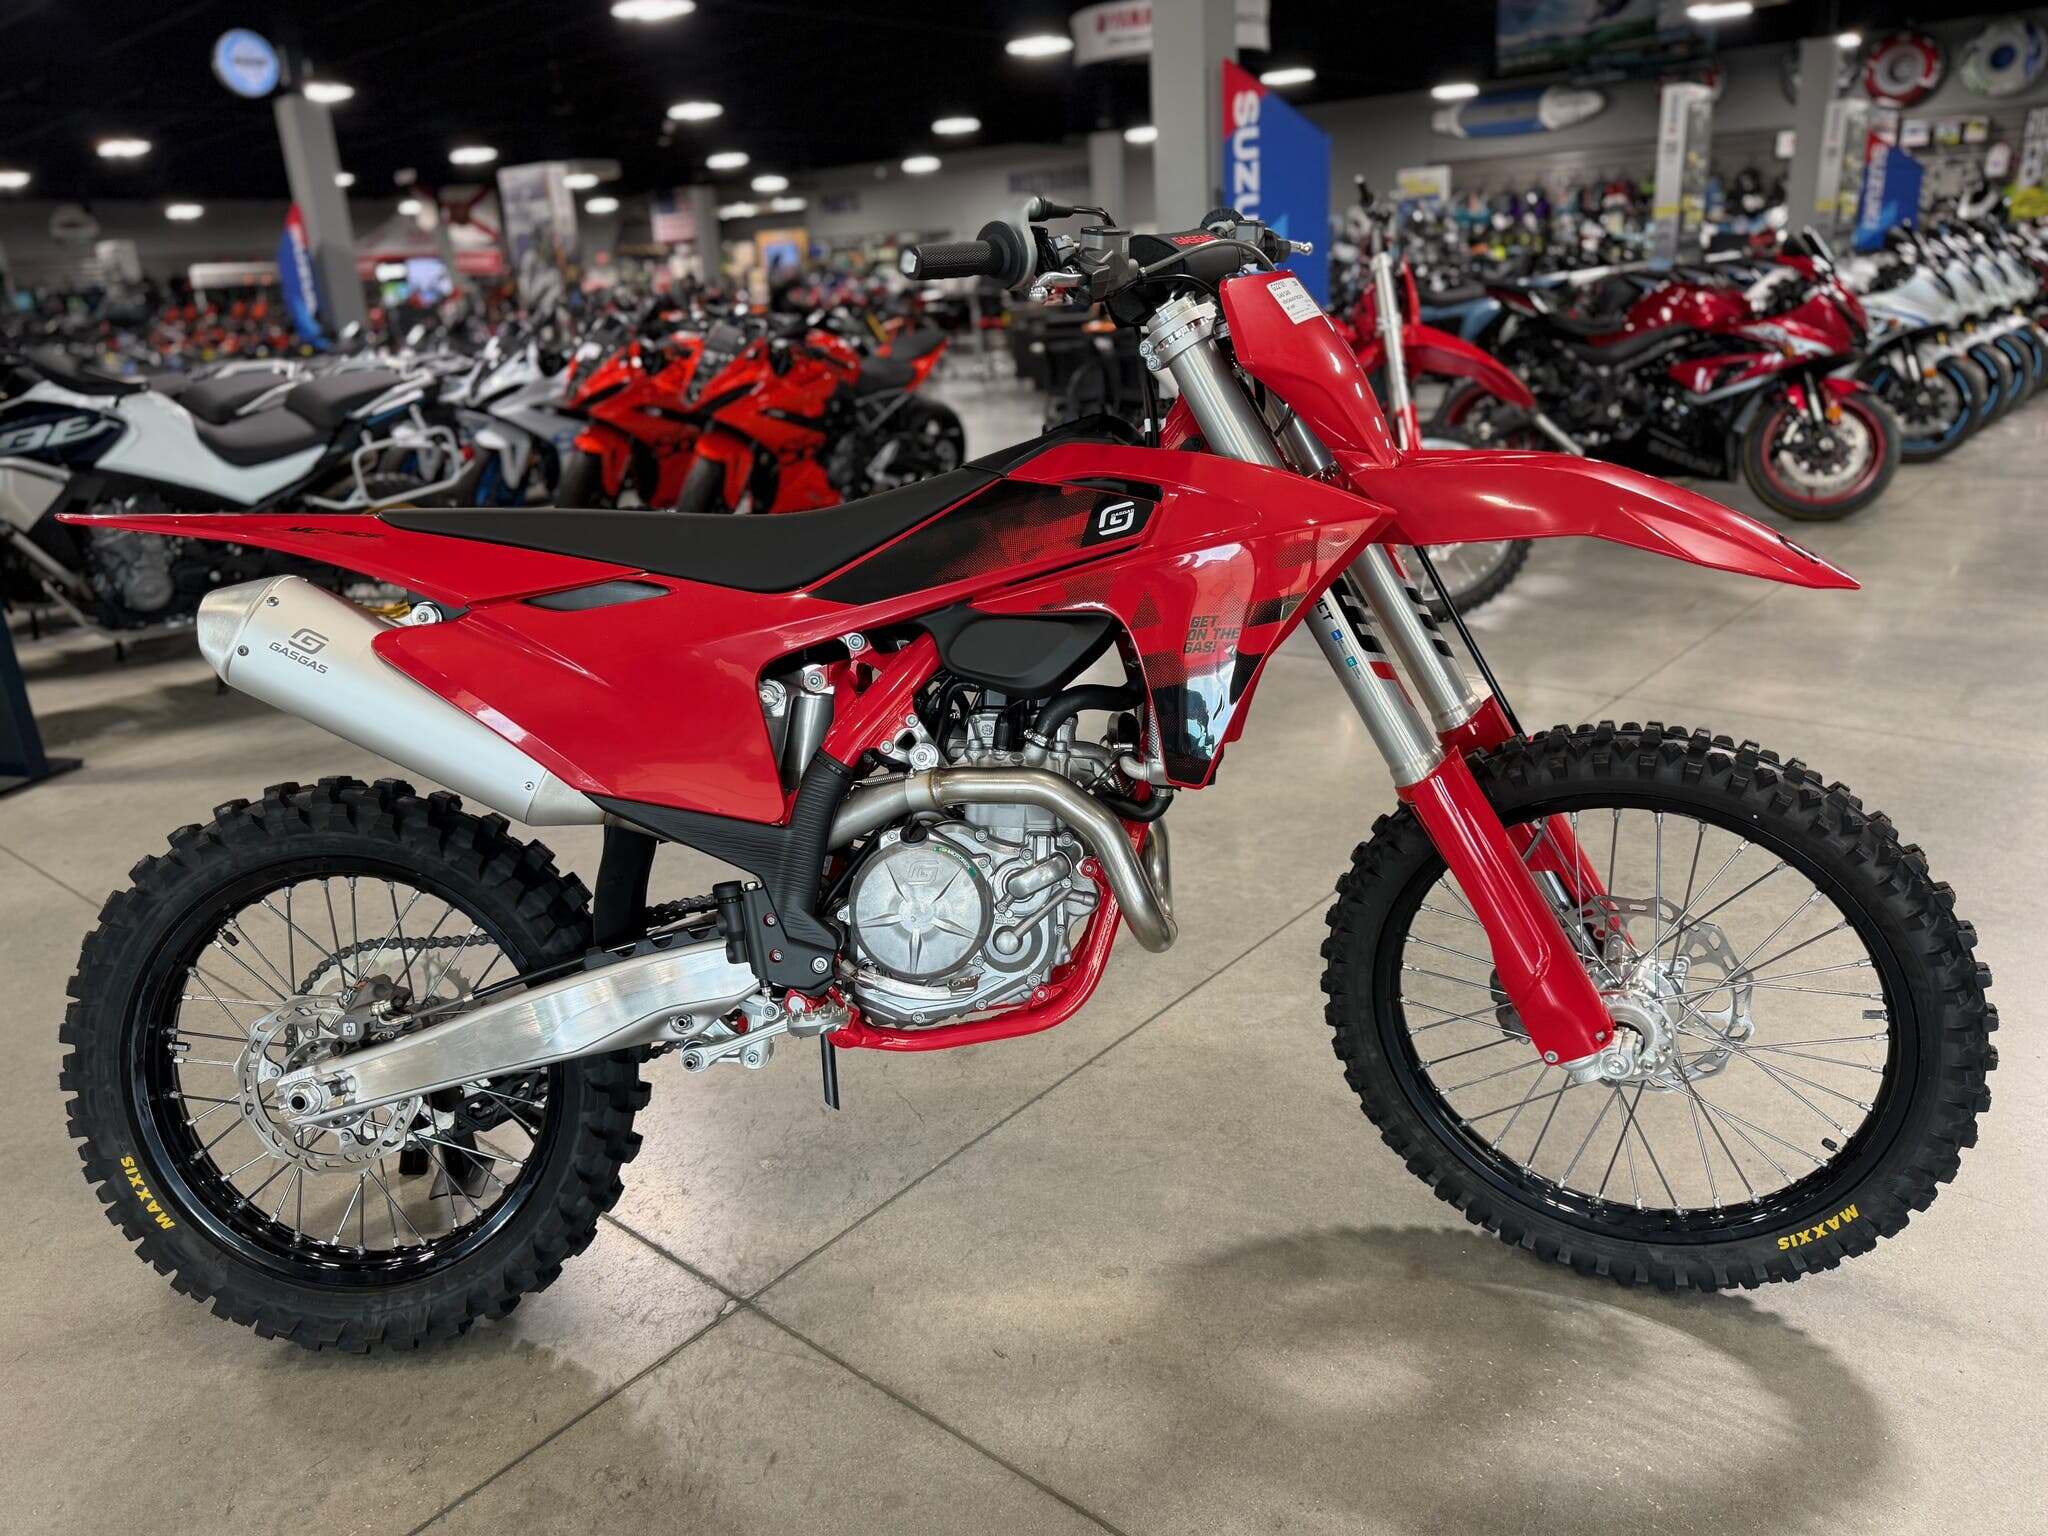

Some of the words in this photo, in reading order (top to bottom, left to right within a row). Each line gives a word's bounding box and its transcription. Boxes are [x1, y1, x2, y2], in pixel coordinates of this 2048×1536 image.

[1232, 89, 1261, 221] SUZU
[1187, 628, 1208, 641] ON
[1213, 627, 1241, 640] THE
[1190, 615, 1219, 629] GET
[268, 641, 329, 674] GASGAS
[120, 1156, 177, 1230] MAXXIS
[1777, 1203, 1860, 1251] MAXXIS
